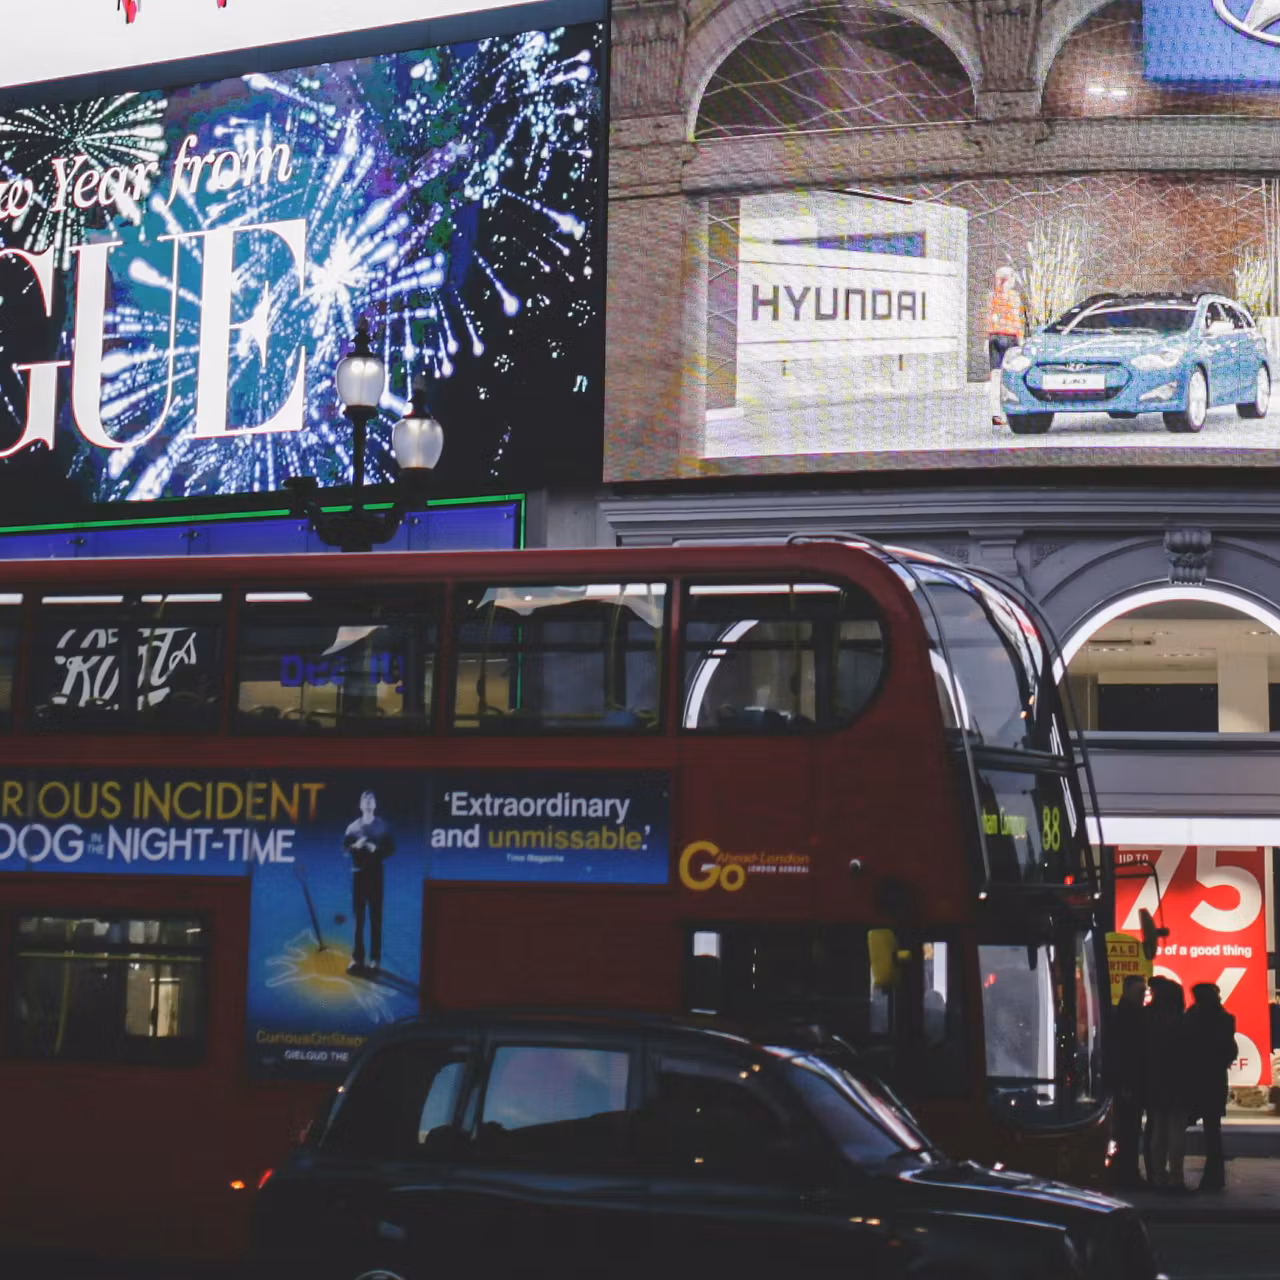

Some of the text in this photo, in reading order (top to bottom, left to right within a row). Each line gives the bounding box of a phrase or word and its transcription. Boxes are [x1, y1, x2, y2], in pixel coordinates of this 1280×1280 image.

[50, 154, 161, 215] Year
[166, 133, 293, 207] from
[751, 283, 927, 321] HYUNDAI
[132, 777, 327, 824] INCIDENT
[106, 824, 296, 865] NIGHT-TIME
[430, 823, 480, 849] and
[1041, 805, 1061, 853] 88
[679, 839, 746, 893] Go
[1118, 845, 1263, 933] 75
[1109, 960, 1139, 972] RTHER
[1110, 945, 1136, 954] ALE
[1164, 944, 1179, 956] of
[1179, 946, 1188, 956] a
[1189, 944, 1221, 959] good
[1222, 944, 1253, 959] thing
